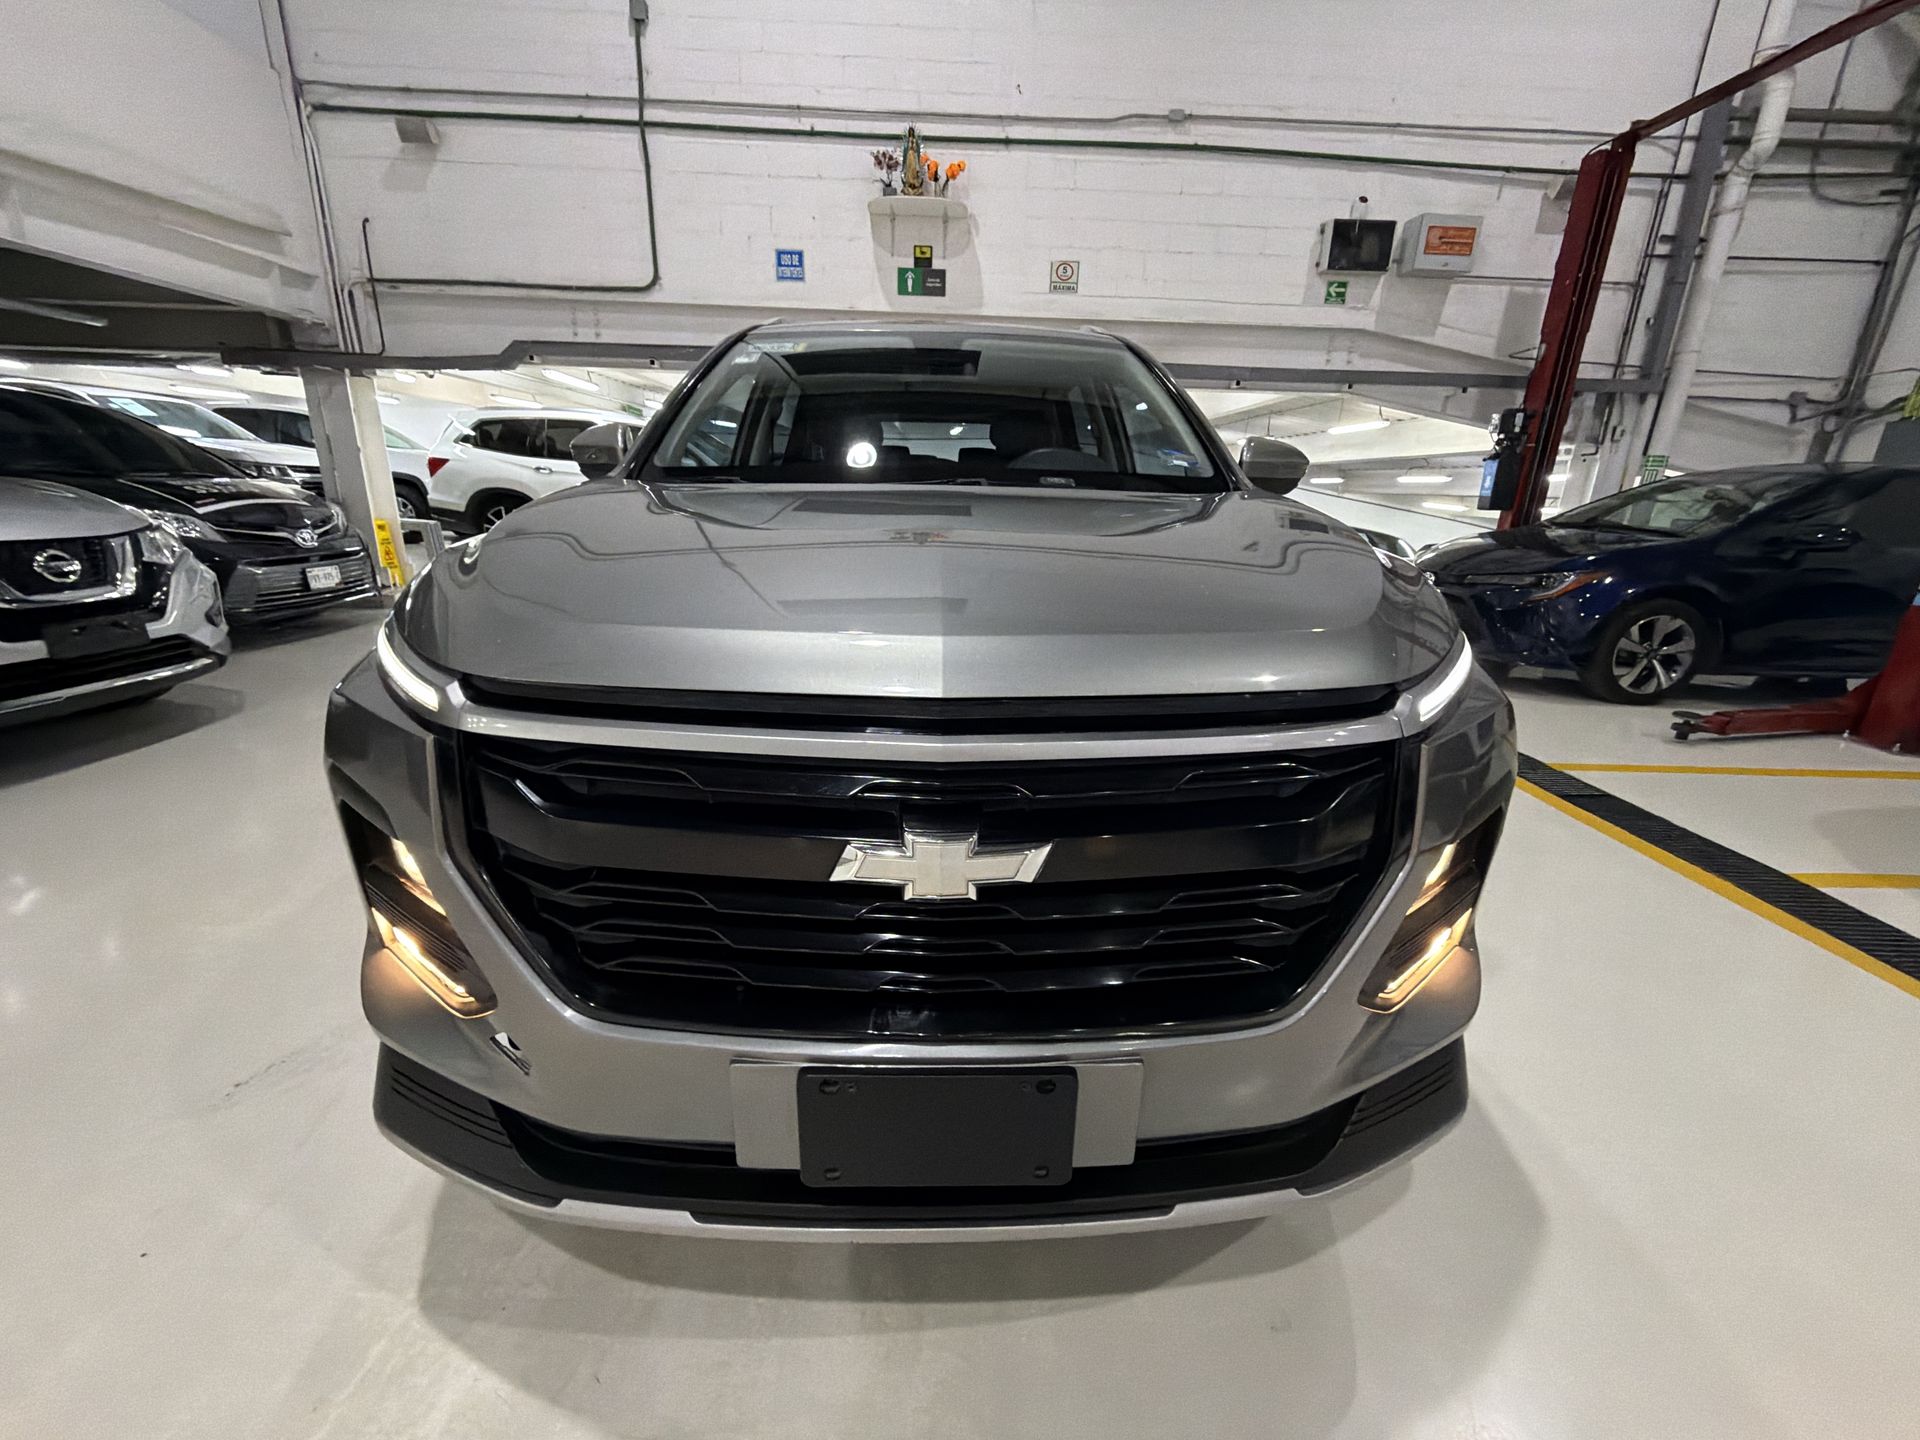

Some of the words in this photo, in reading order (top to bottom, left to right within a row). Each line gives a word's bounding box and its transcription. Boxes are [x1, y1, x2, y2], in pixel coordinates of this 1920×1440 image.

[780, 254, 791, 265] USO
[792, 254, 800, 265] DE
[1062, 266, 1068, 274] 5
